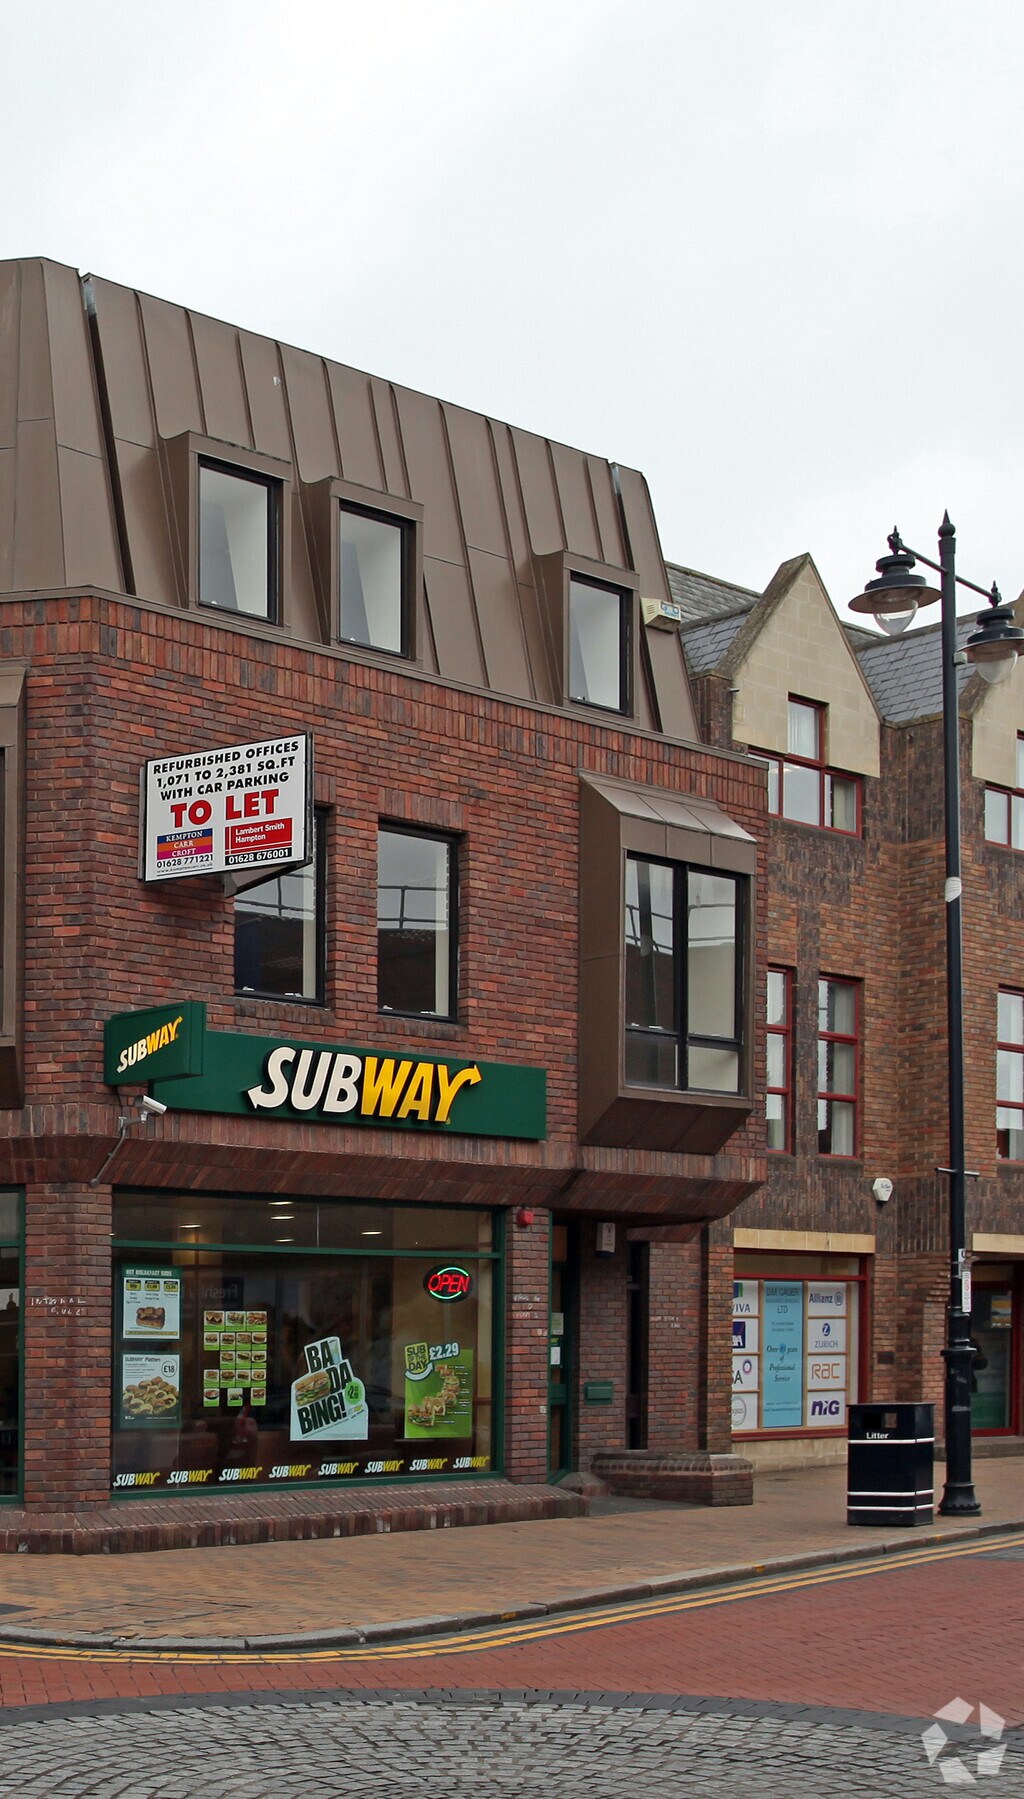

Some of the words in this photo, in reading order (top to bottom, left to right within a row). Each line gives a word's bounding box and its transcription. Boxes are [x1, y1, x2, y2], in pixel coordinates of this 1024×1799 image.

[153, 750, 241, 775] REFURBISHED
[245, 740, 299, 760] OFFICES
[156, 771, 190, 789] 1,071
[194, 769, 212, 782] TO
[216, 763, 252, 779] 2,381
[257, 755, 296, 772] SQ.FT
[160, 786, 193, 801] WITH
[197, 782, 223, 796] CAR
[227, 771, 290, 790] PARKING
[170, 799, 213, 828] TO
[225, 788, 280, 821] LET
[166, 830, 203, 842] KEMPTON
[235, 826, 264, 836] Lambert
[264, 822, 285, 832] Smith
[173, 840, 195, 849] CARR
[235, 833, 266, 844] Hampton
[171, 847, 197, 857] CROFT
[228, 853, 255, 865] 01628
[256, 848, 289, 860] 676001
[156, 858, 182, 869] 01628
[184, 853, 213, 865] 771221
[116, 1015, 184, 1074] SUBWAY
[246, 1045, 482, 1123] SUBWAY
[427, 1274, 471, 1293] OPEN
[808, 1292, 834, 1304] Allianz
[407, 1344, 426, 1357] SUB
[429, 1342, 459, 1360] £2.29
[814, 1340, 839, 1349] ZURICH
[306, 1340, 335, 1373] BA
[163, 1365, 175, 1373] £18
[408, 1359, 427, 1371] DAY
[325, 1362, 353, 1394] DA
[297, 1391, 348, 1435] BING!
[866, 1432, 889, 1440] Litter
[317, 1461, 359, 1477] SUBWAY
[364, 1459, 405, 1474] SUBWAY
[409, 1457, 448, 1471] SUBWAY
[452, 1455, 490, 1469] SUBWAY
[113, 1470, 160, 1488] SUBWAY
[166, 1468, 213, 1484] SUBWAY
[218, 1465, 263, 1482] SUBWAY
[268, 1463, 312, 1479] SUBWAY
